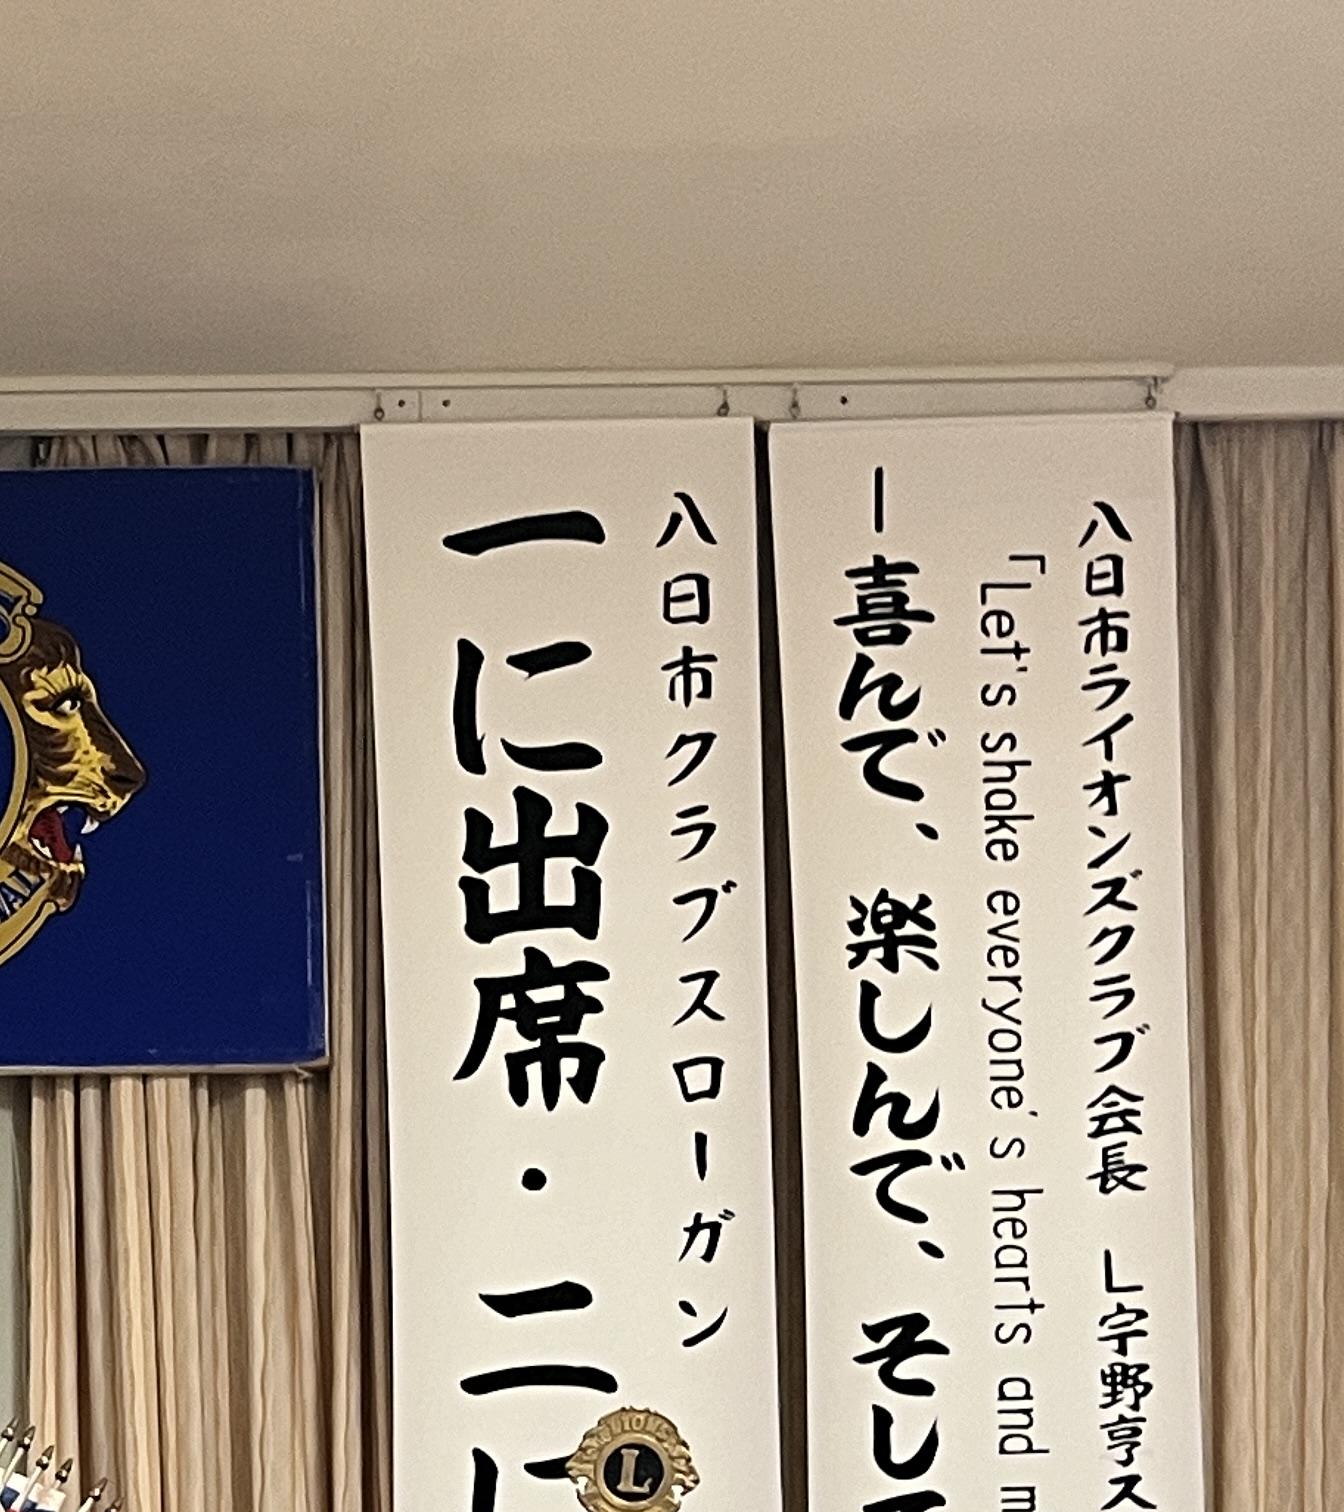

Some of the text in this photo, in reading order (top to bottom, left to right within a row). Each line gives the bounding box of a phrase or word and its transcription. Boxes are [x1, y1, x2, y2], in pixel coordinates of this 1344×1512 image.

[980, 731, 1036, 862] shake
[1077, 498, 1149, 1196] 八日市ライオンズクラブ会長
[655, 490, 738, 1350] 八日市クラブスローガン
[980, 889, 1039, 1160] everyone's
[990, 1187, 1046, 1345] hearts
[616, 1448, 654, 1495] L
[996, 1376, 1050, 1456] and
